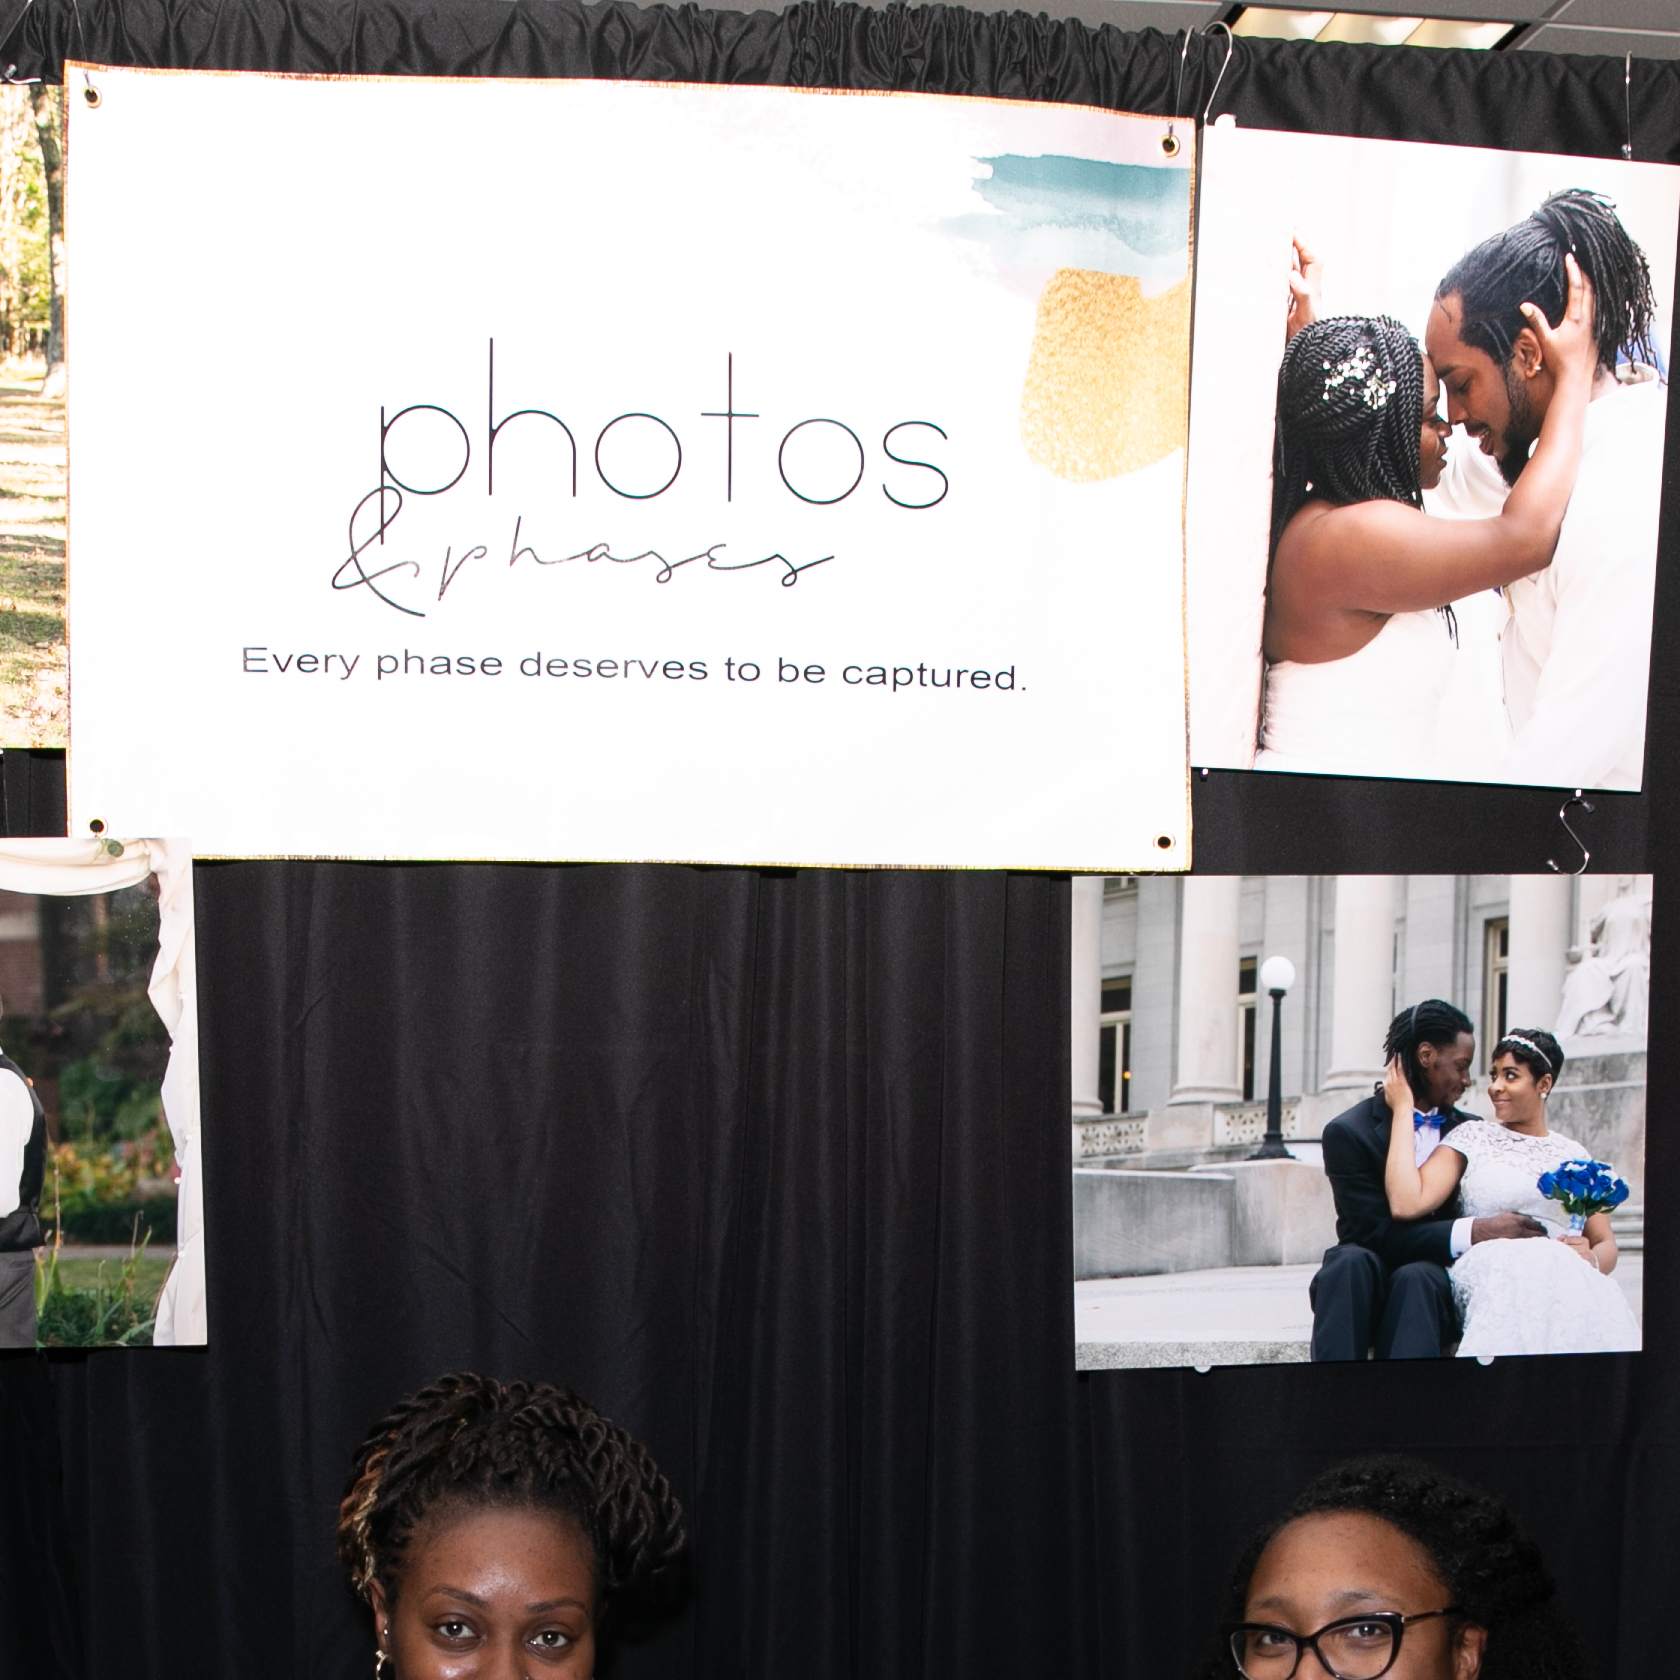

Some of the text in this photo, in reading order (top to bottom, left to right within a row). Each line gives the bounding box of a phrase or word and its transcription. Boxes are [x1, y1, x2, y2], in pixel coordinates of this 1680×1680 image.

[380, 337, 949, 545] photos
[332, 485, 835, 617] & phases
[241, 645, 1028, 693] Every phase deserves to be captured.
